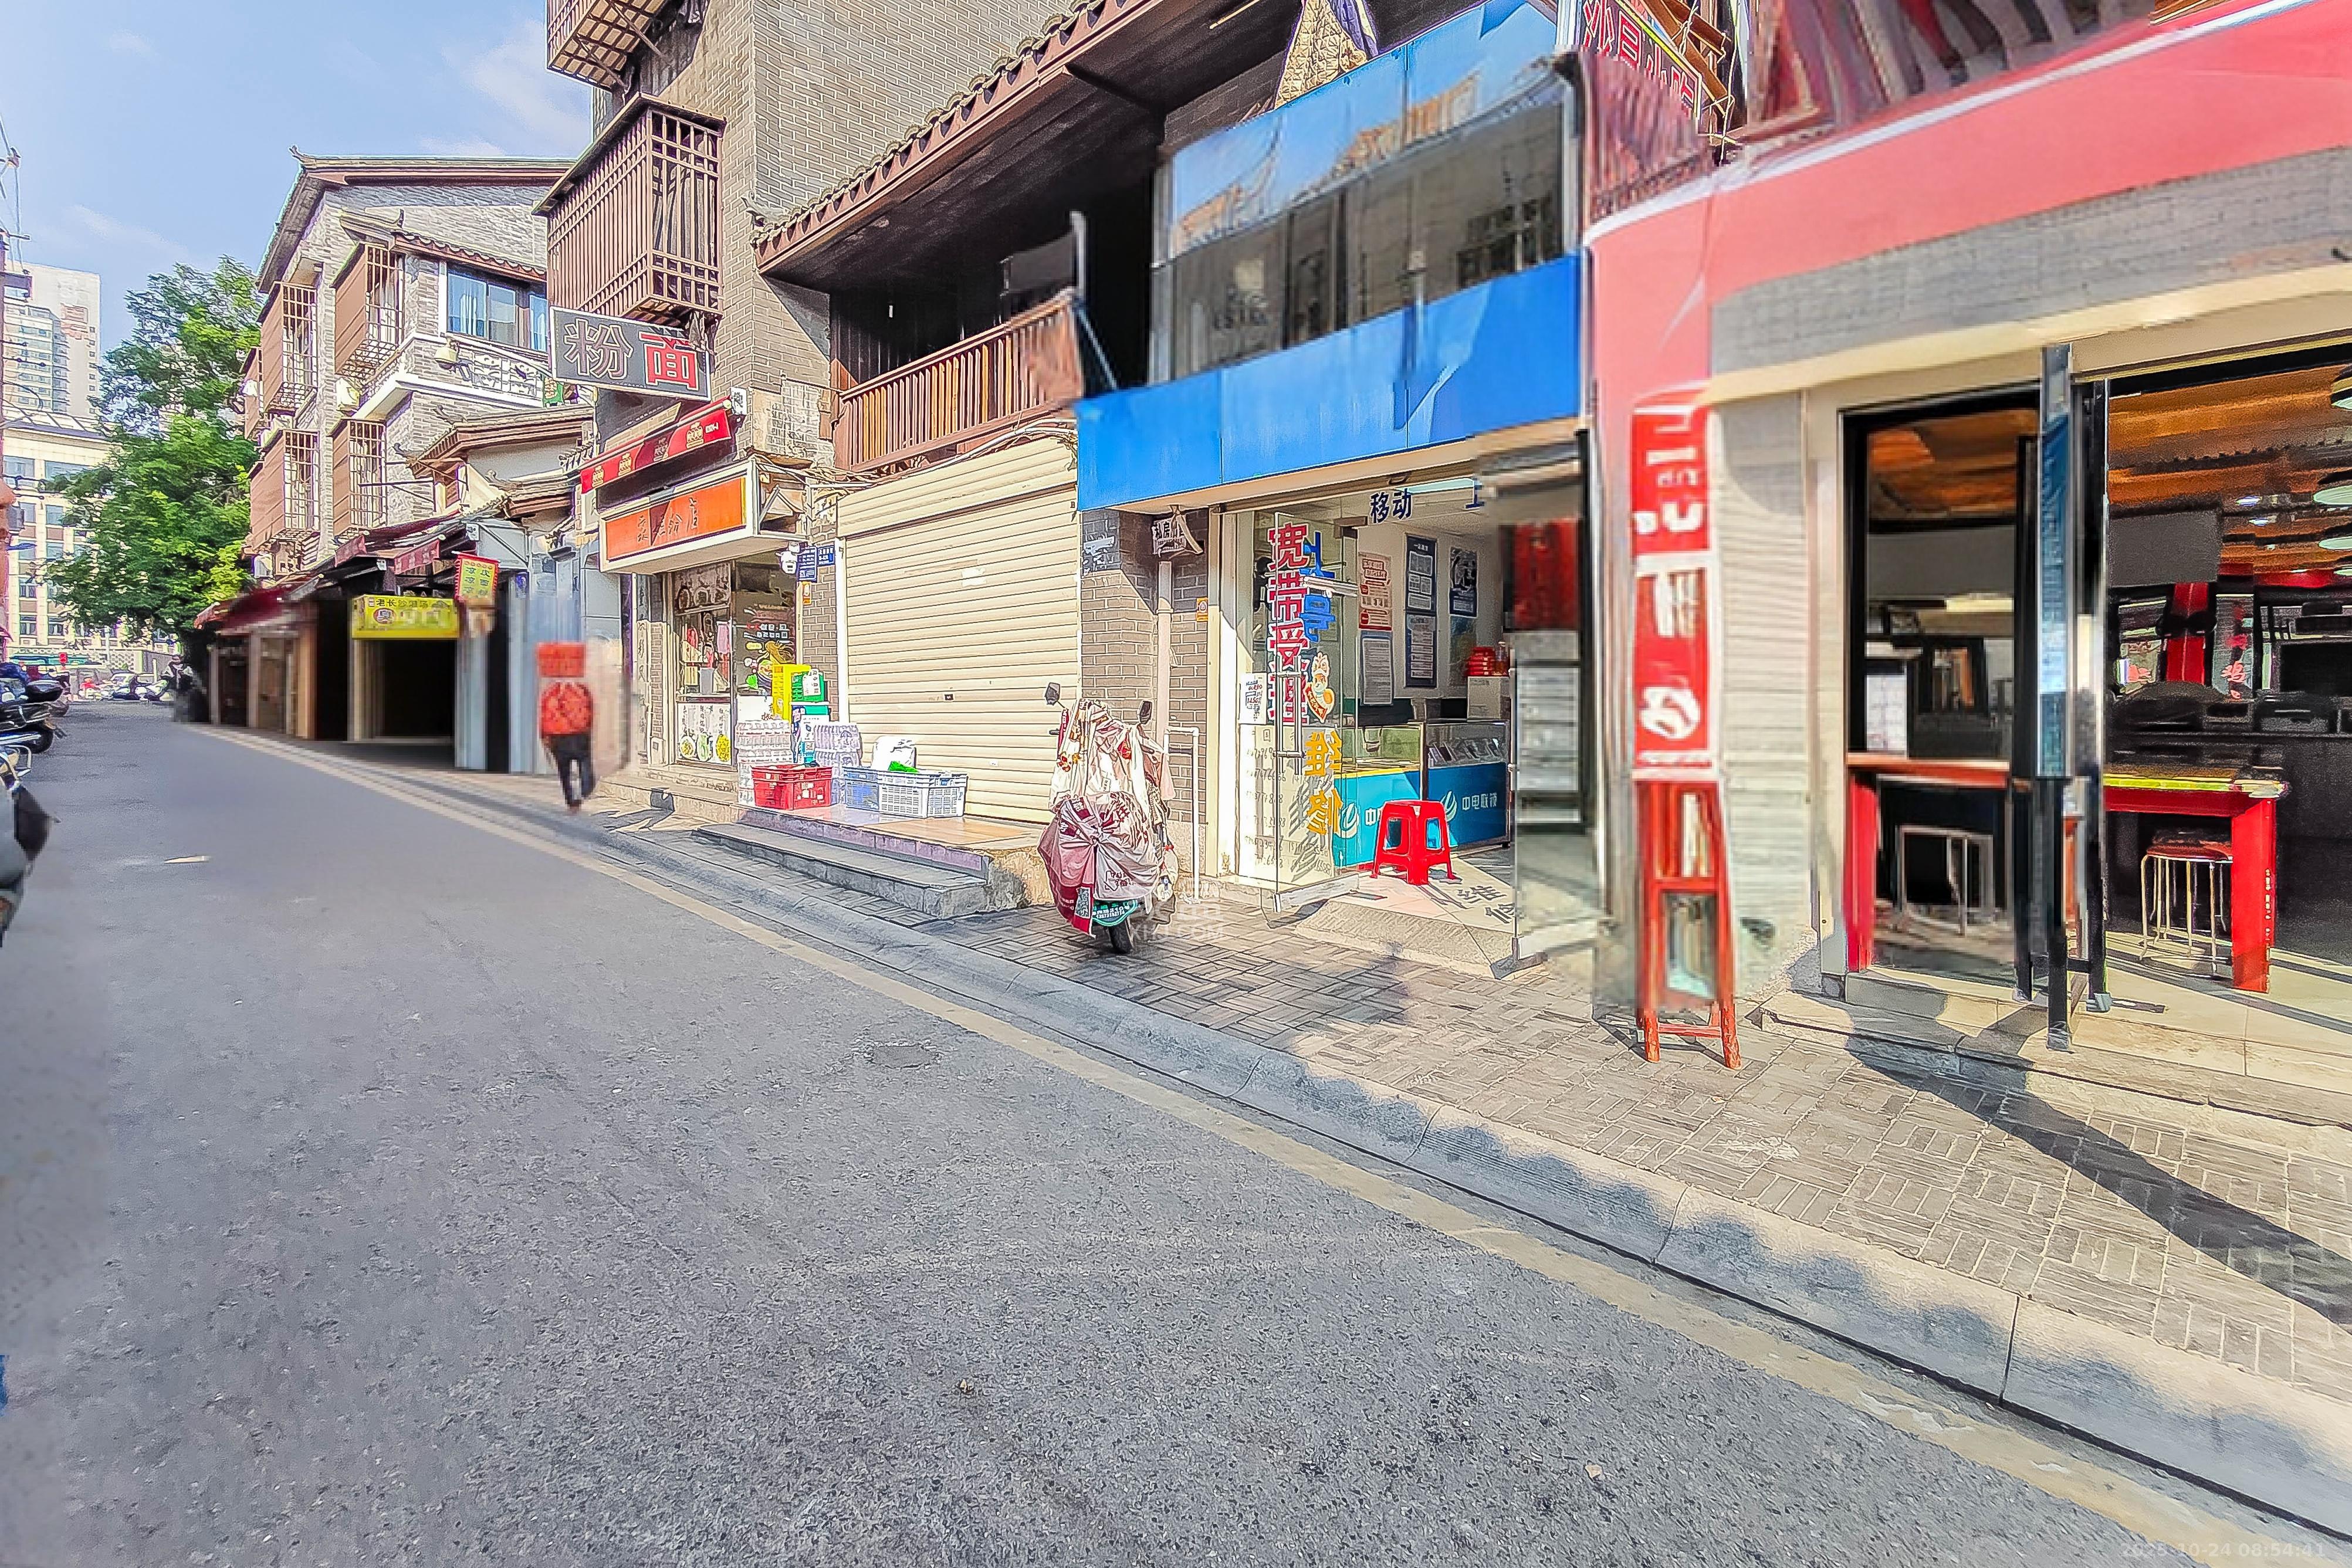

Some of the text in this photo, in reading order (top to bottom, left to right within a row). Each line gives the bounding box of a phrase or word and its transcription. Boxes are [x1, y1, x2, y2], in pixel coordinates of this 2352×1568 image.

[564, 319, 699, 391] 粉面
[1370, 488, 1412, 524] 移动
[1267, 523, 1310, 726] 宽带受理
